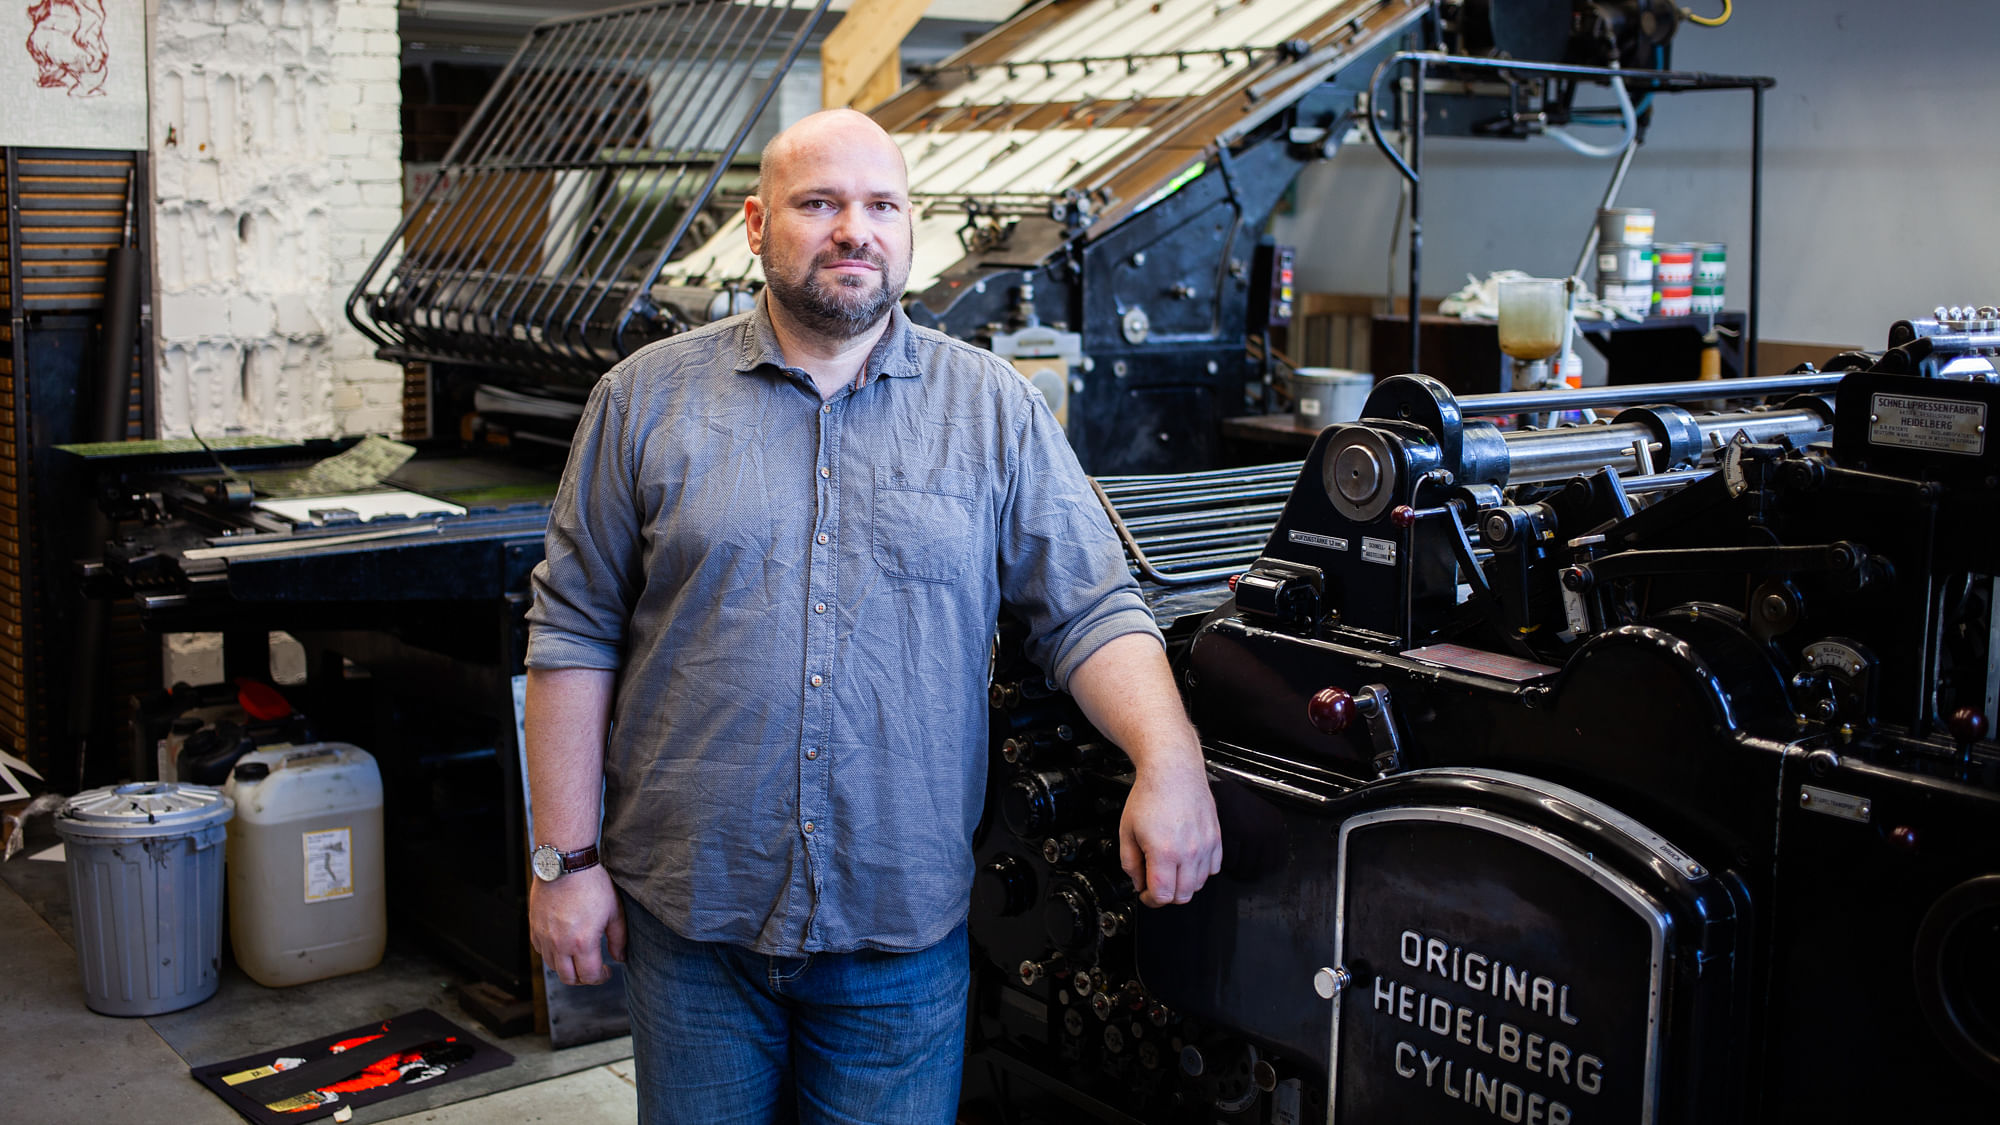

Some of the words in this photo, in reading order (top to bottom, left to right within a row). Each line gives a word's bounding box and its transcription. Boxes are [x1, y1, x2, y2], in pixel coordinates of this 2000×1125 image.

[1878, 398, 1979, 416] SCHNELLPRESSENFABRIK
[1901, 417, 1952, 430] HEIDELBERG
[1660, 845, 1681, 862] DRUCK
[1400, 929, 1580, 1025] ORIGINAL
[1373, 975, 1604, 1095] HEIDELBERG
